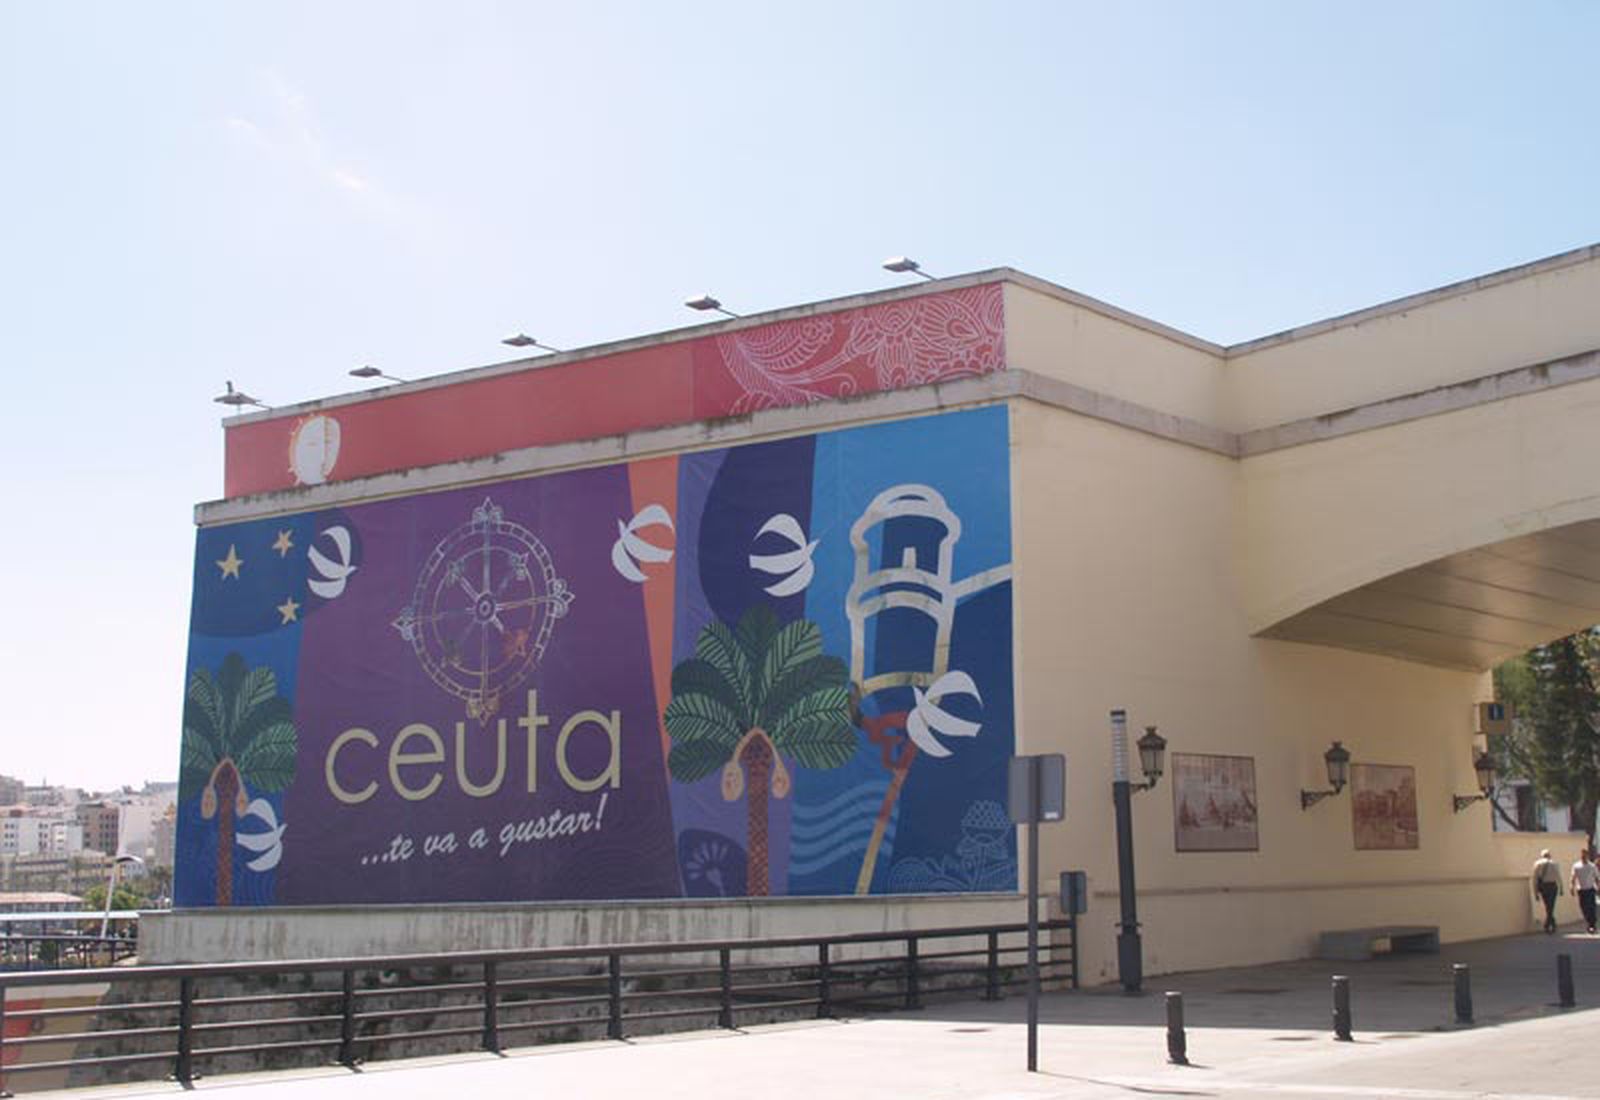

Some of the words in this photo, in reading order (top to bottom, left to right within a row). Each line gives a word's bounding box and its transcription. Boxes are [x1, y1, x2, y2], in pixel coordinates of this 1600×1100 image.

[325, 689, 621, 803] ceuta
[424, 832, 458, 855] va
[468, 827, 489, 848] a
[500, 793, 608, 856] gustar!
